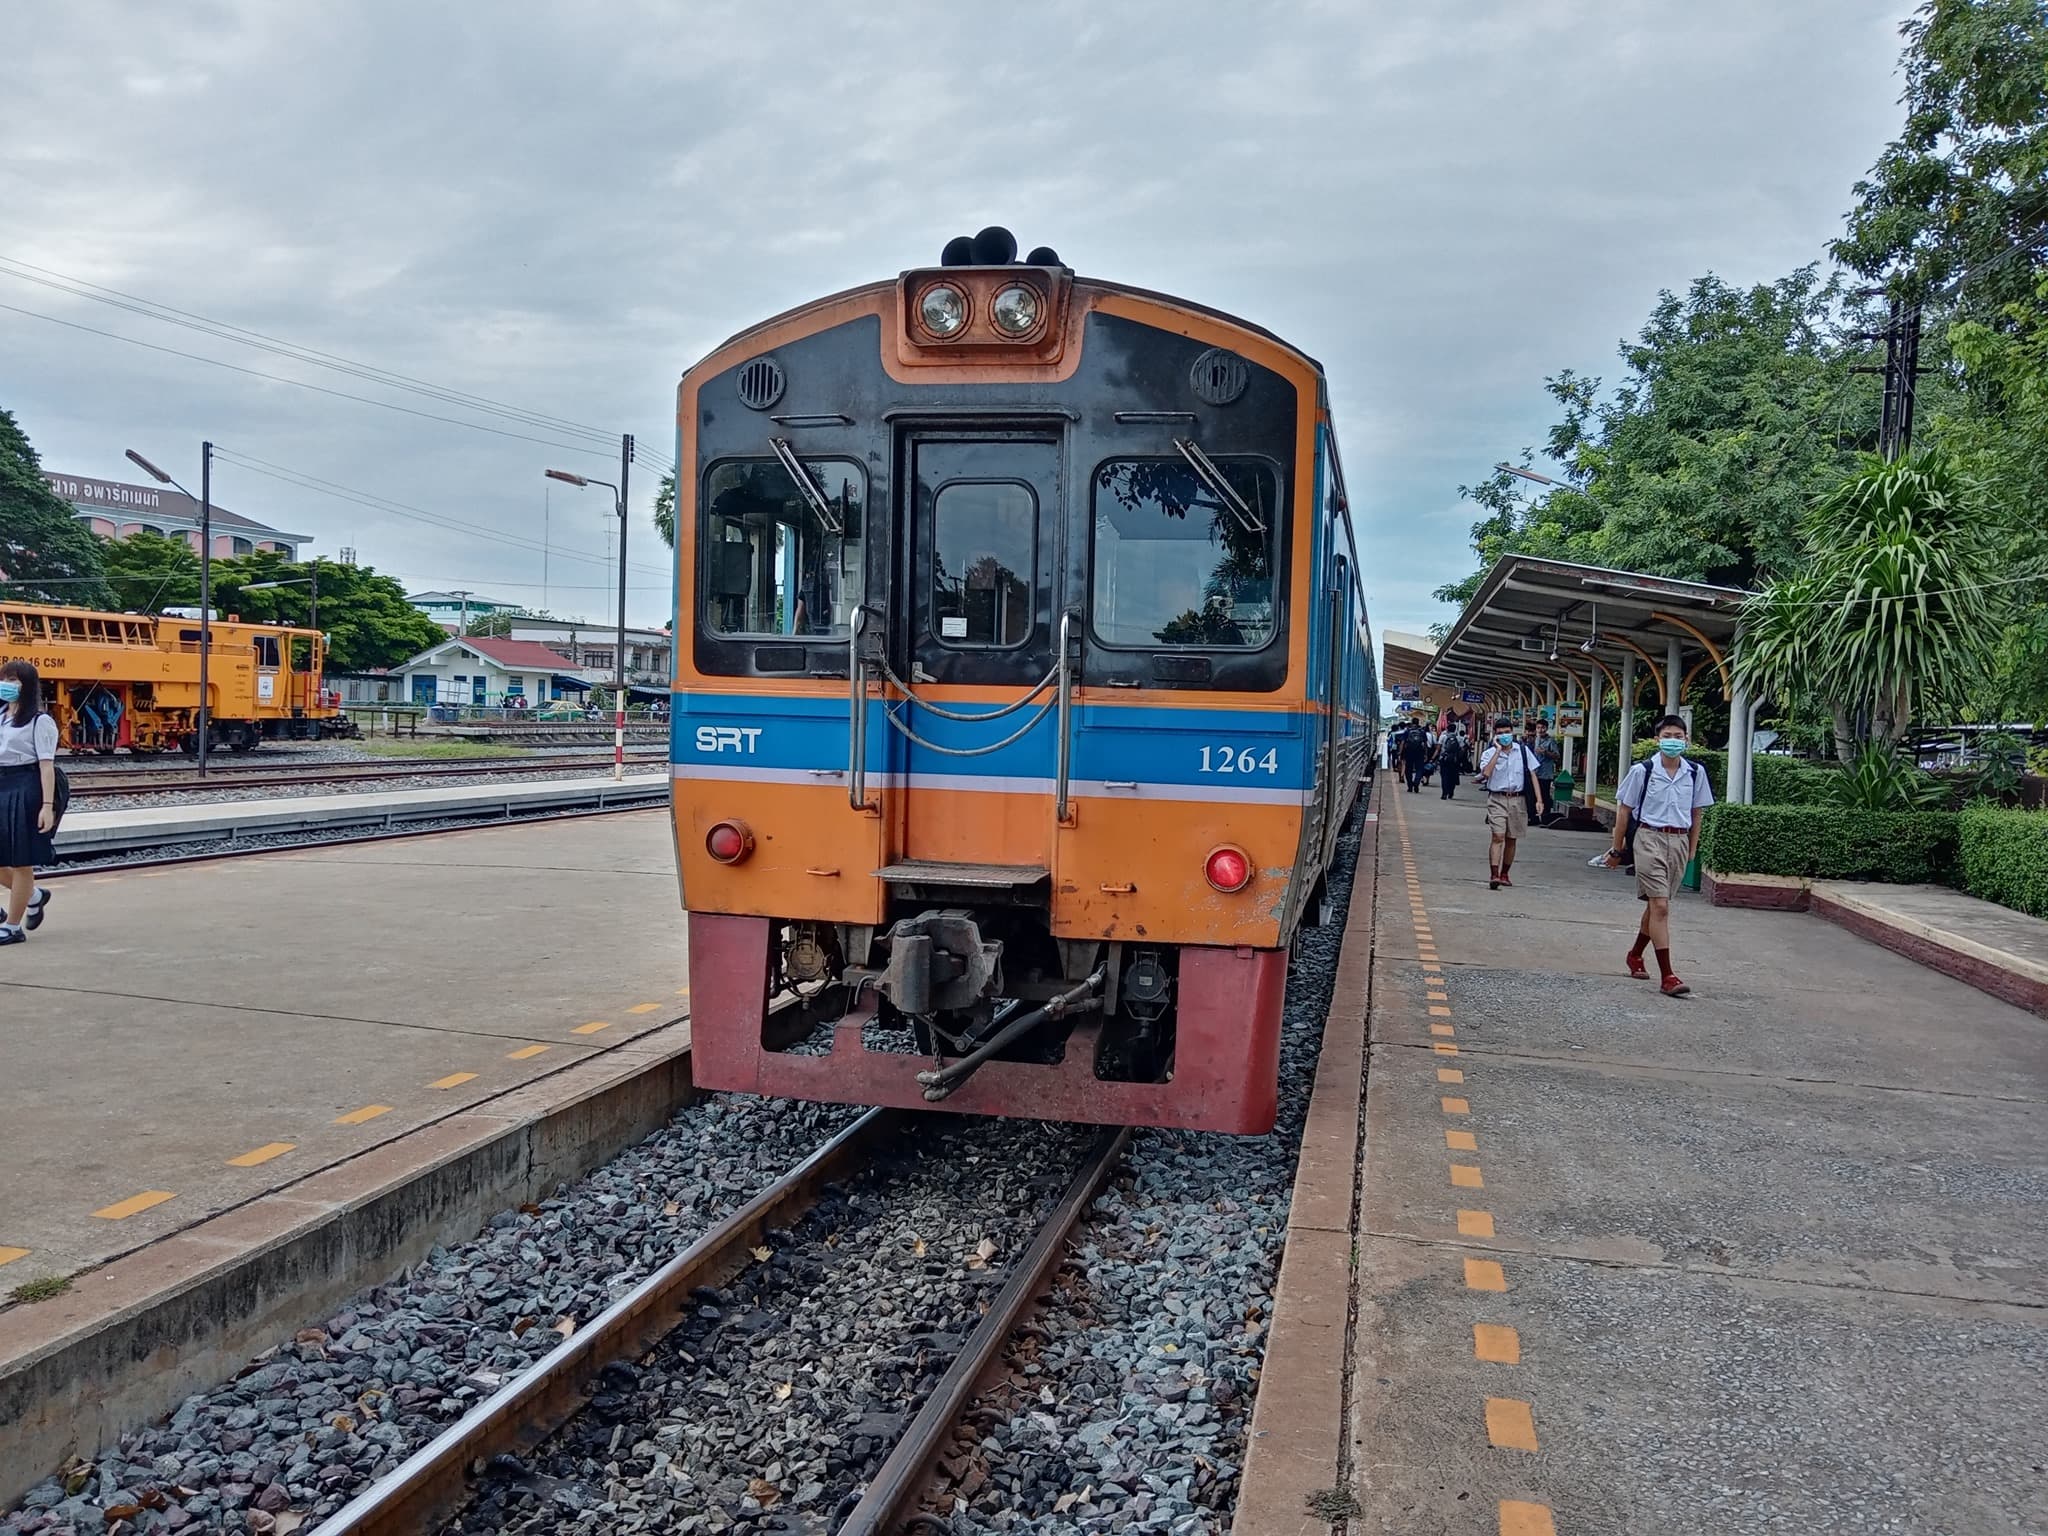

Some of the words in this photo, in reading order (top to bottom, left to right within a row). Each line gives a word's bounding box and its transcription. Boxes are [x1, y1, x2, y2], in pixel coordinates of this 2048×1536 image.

[43, 657, 65, 669] CSM
[695, 726, 763, 754] SRT
[1198, 745, 1278, 774] 1264
